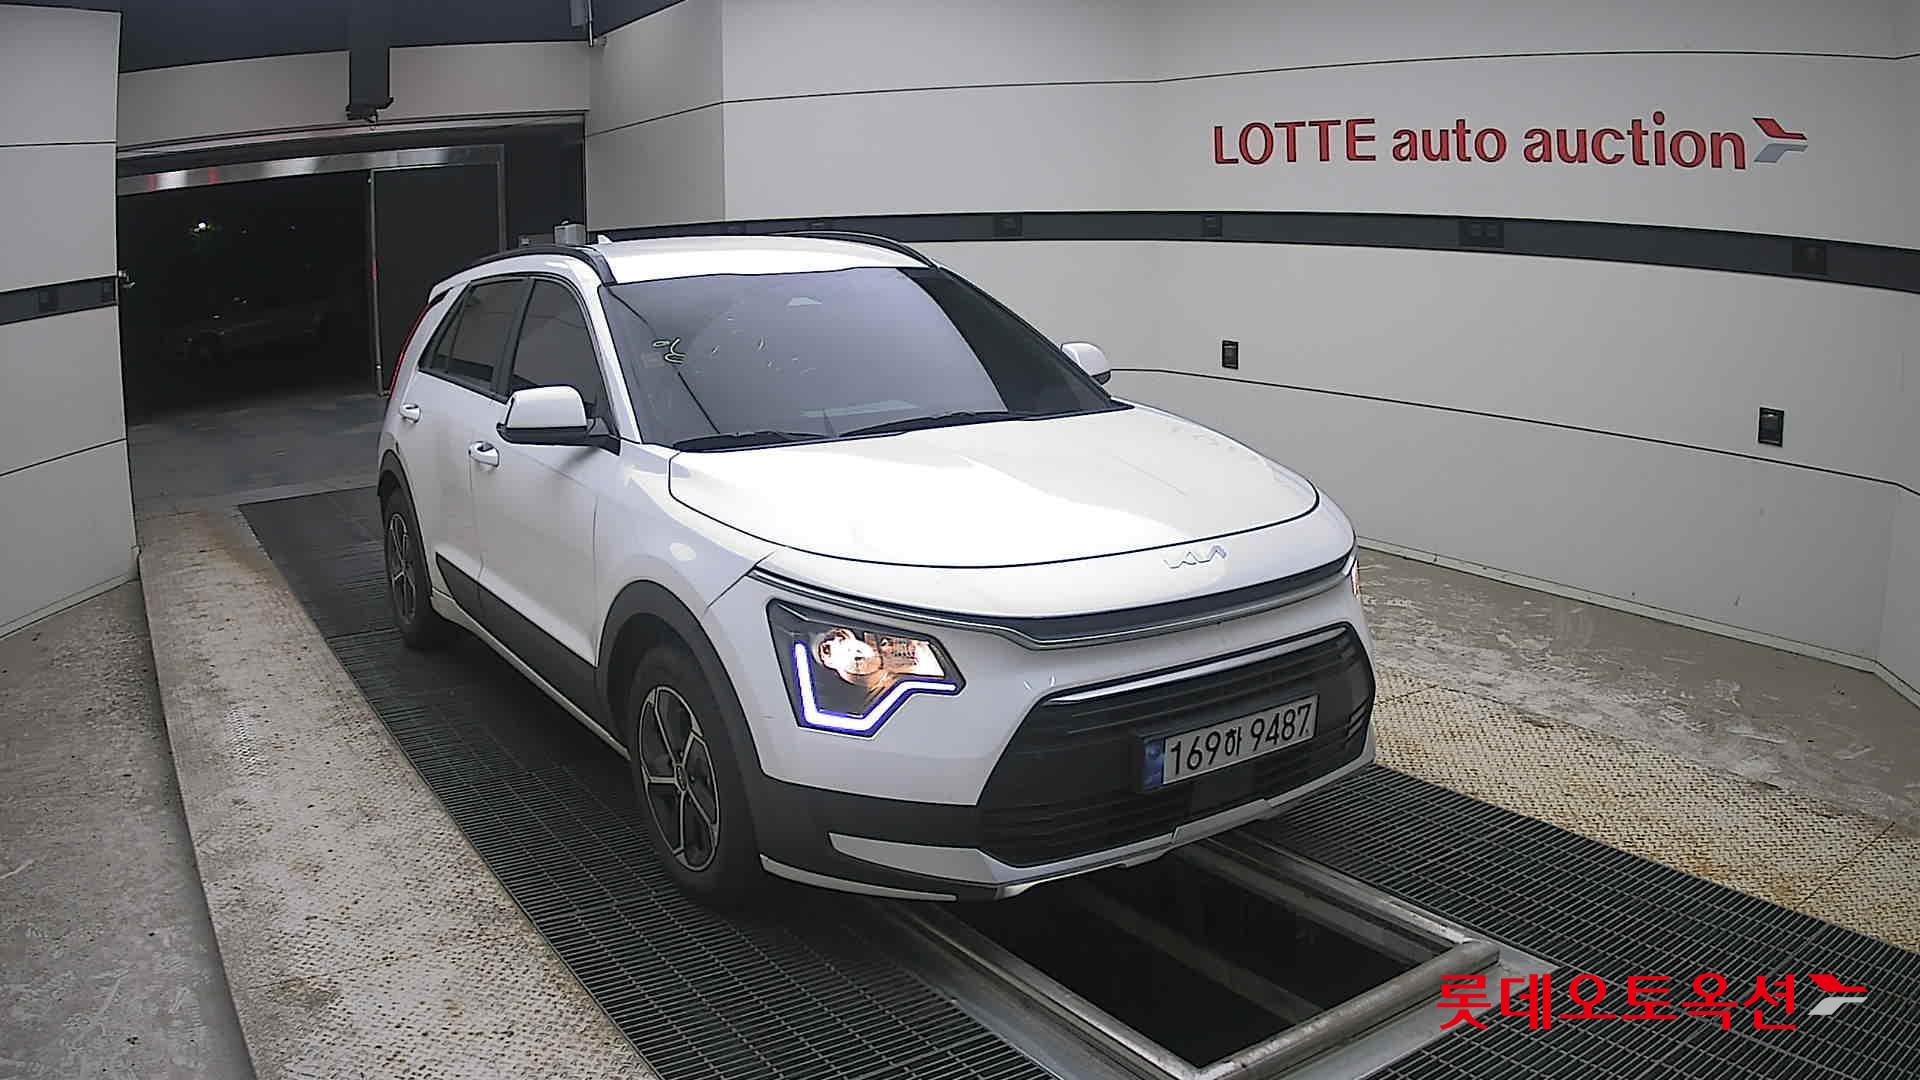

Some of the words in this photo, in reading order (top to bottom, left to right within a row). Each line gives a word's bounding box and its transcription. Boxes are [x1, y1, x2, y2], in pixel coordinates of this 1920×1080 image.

[1213, 117, 1377, 164] LOTTE
[1391, 117, 1507, 163] auto
[1523, 111, 1746, 170] auction
[1170, 725, 1243, 776] 169하
[1250, 702, 1314, 752] 9487
